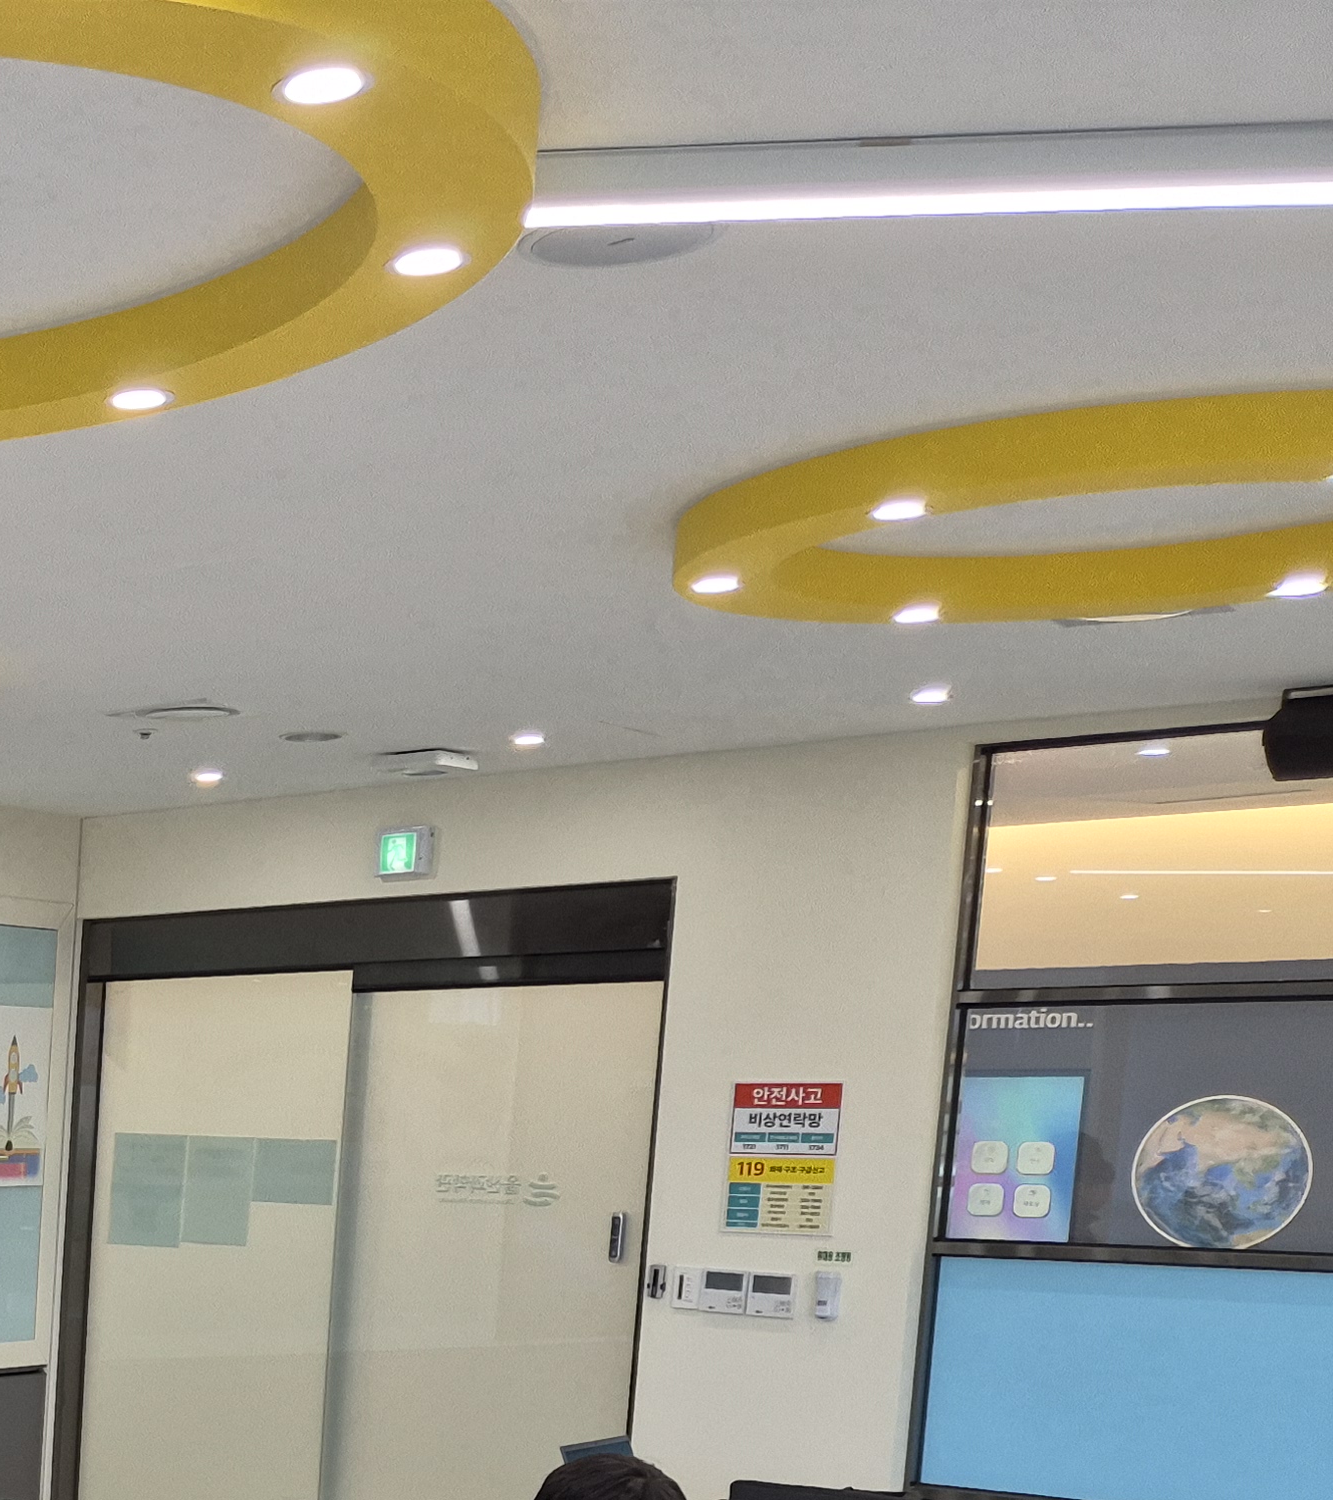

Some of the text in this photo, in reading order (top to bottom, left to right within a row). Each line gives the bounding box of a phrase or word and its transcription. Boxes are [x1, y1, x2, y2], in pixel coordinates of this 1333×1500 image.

[752, 1086, 823, 1106] 안전사고
[748, 1112, 824, 1129] 비상연락망
[737, 1161, 765, 1177] 119
